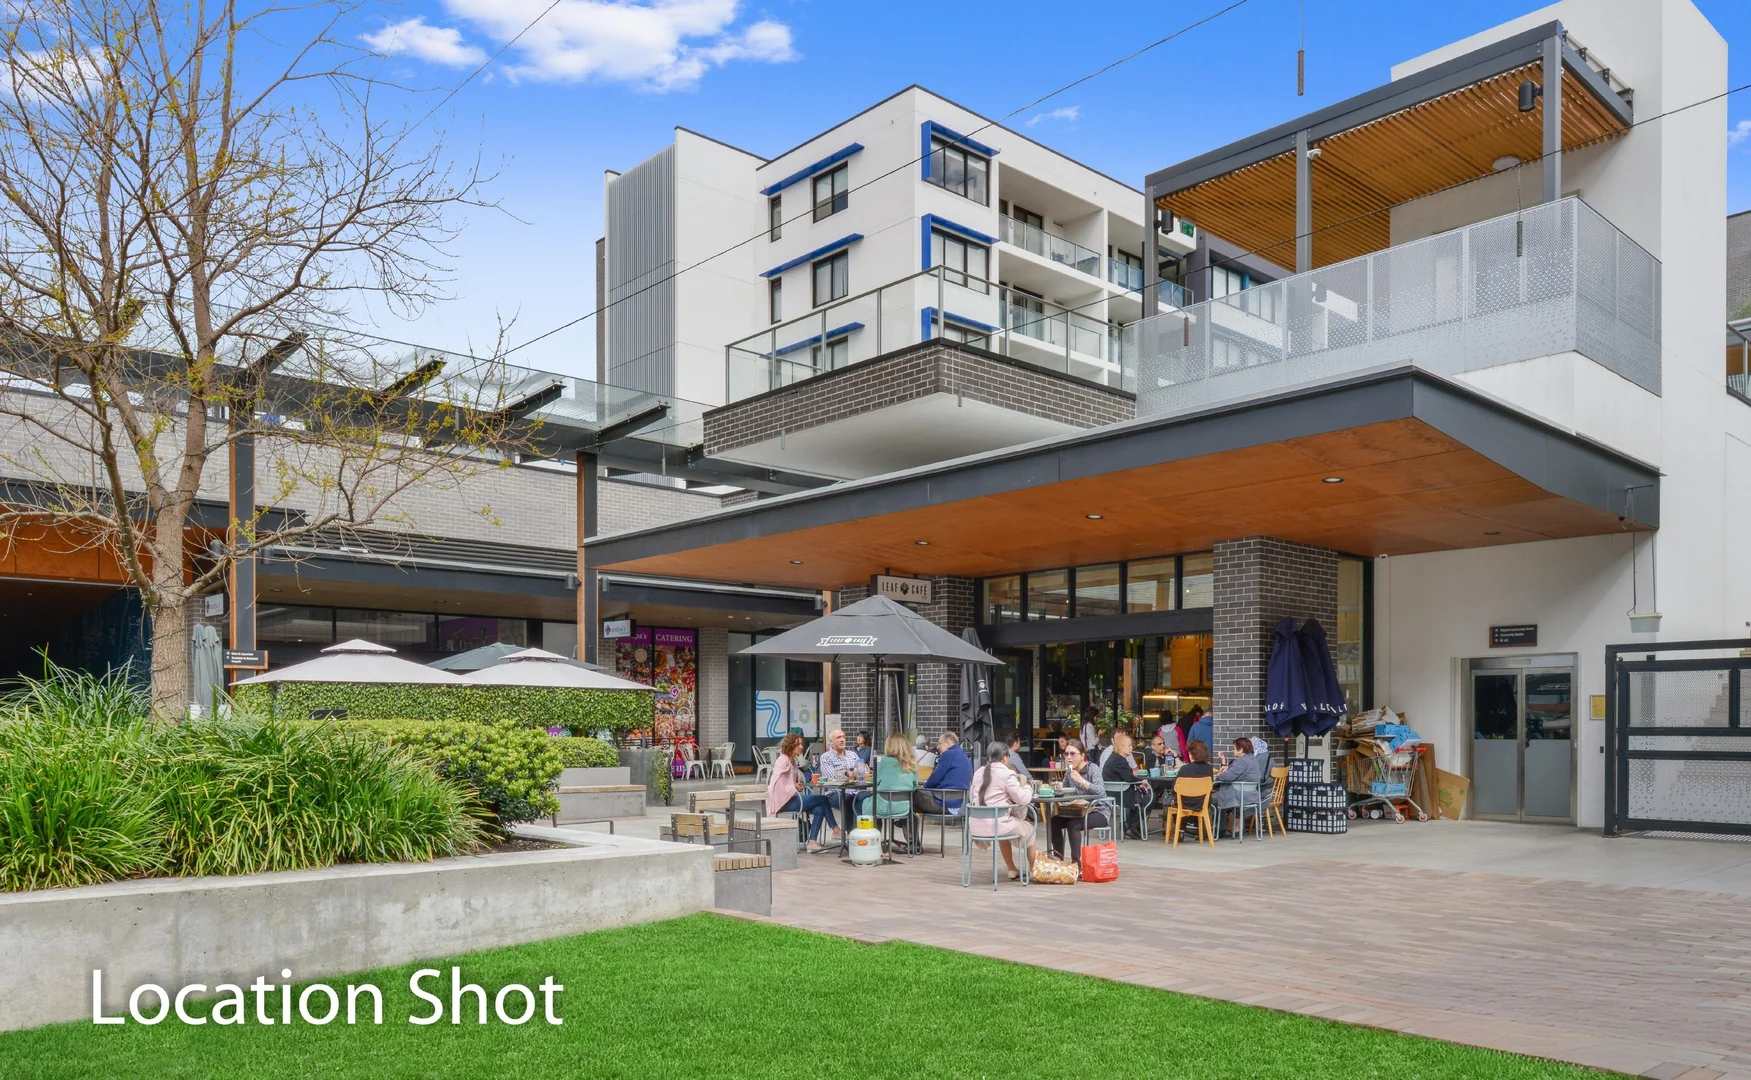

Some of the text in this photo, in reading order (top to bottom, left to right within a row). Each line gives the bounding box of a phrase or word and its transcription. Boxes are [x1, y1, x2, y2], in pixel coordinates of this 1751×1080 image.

[881, 581, 927, 595] LEAF CAFÉ
[655, 634, 693, 643] CATERING
